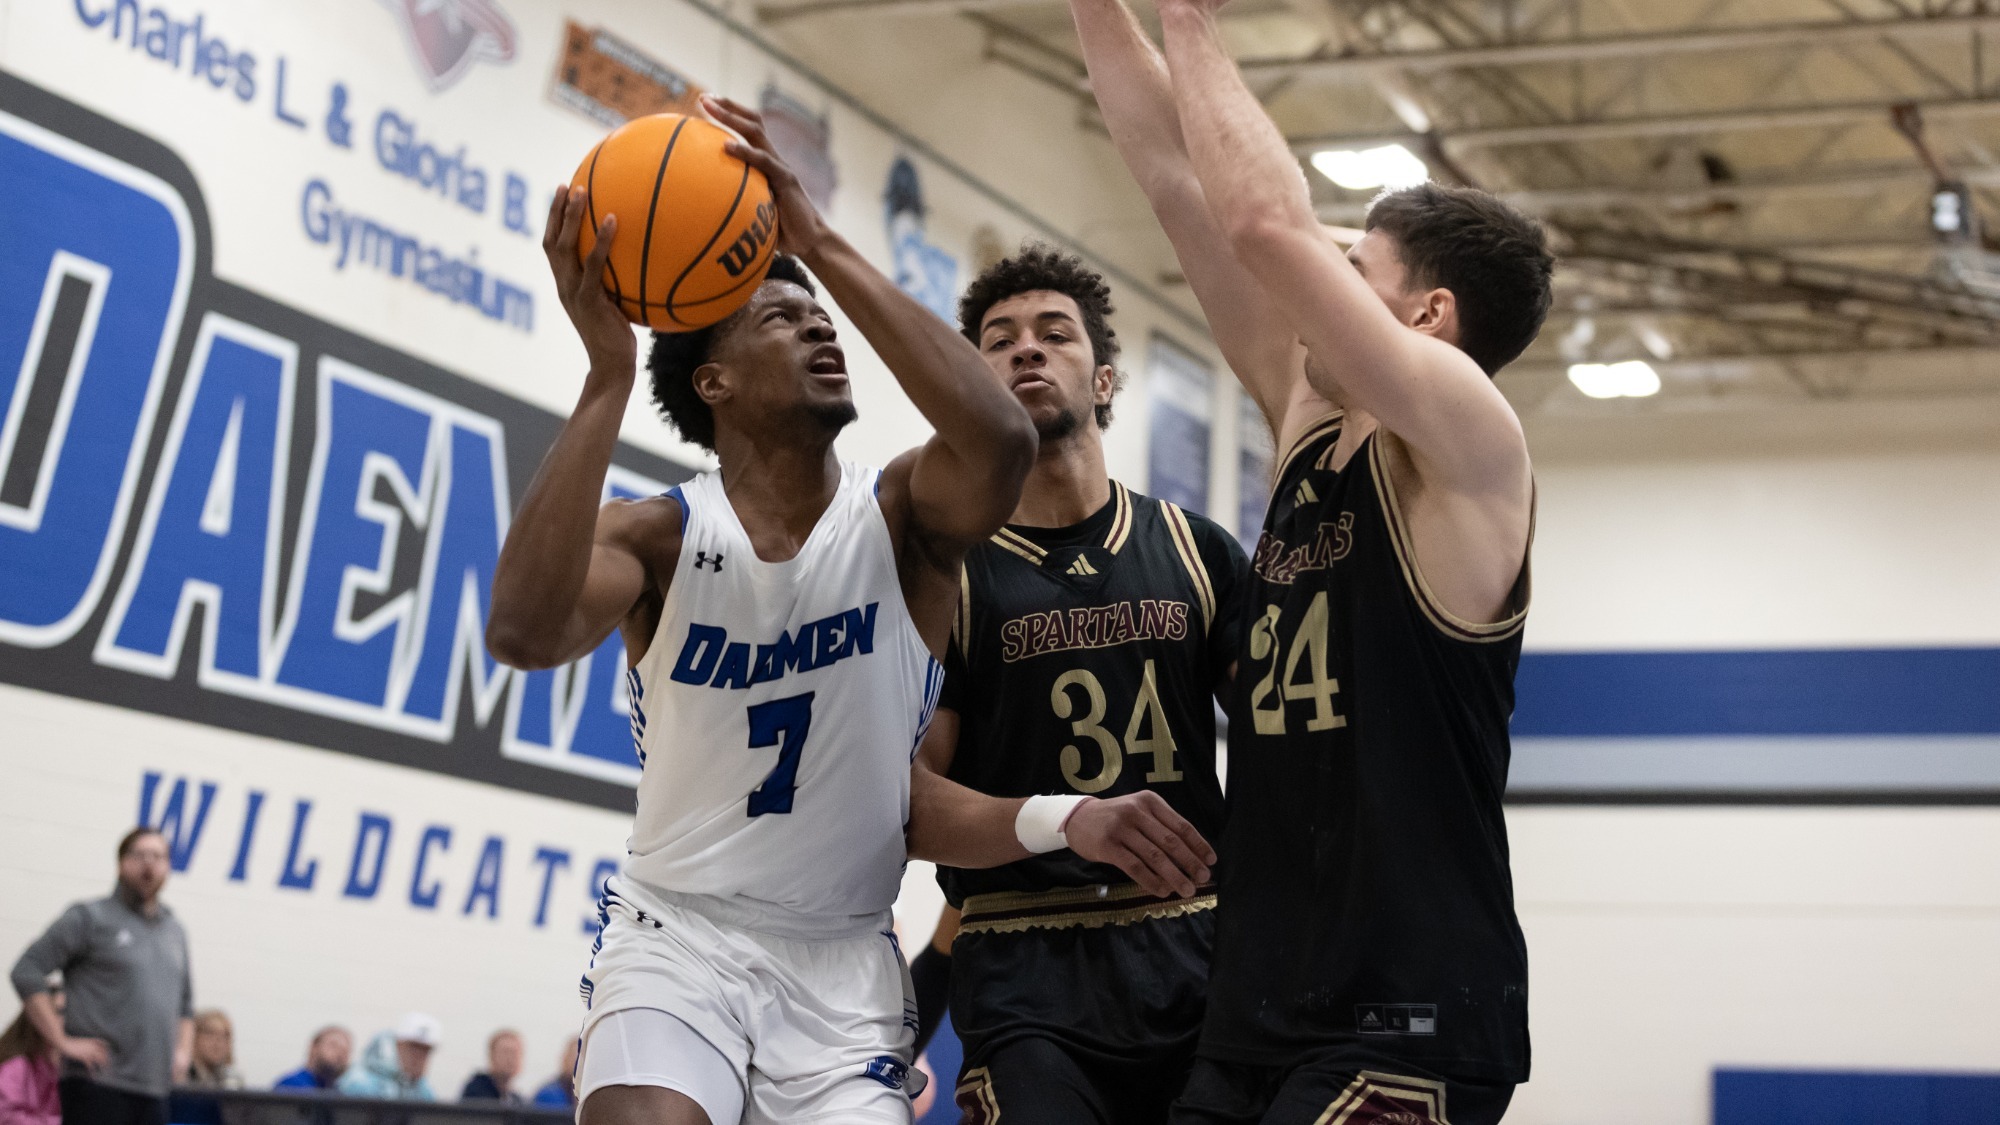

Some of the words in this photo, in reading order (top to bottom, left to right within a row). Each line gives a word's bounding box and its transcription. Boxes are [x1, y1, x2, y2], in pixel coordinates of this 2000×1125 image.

[326, 83, 353, 149] &
[374, 109, 487, 214] Gloria
[301, 178, 535, 331] Gymnasium
[1001, 600, 1189, 663] SPARTANS
[1251, 591, 1346, 735] 24
[746, 691, 816, 818] 7
[1050, 658, 1183, 793] 34
